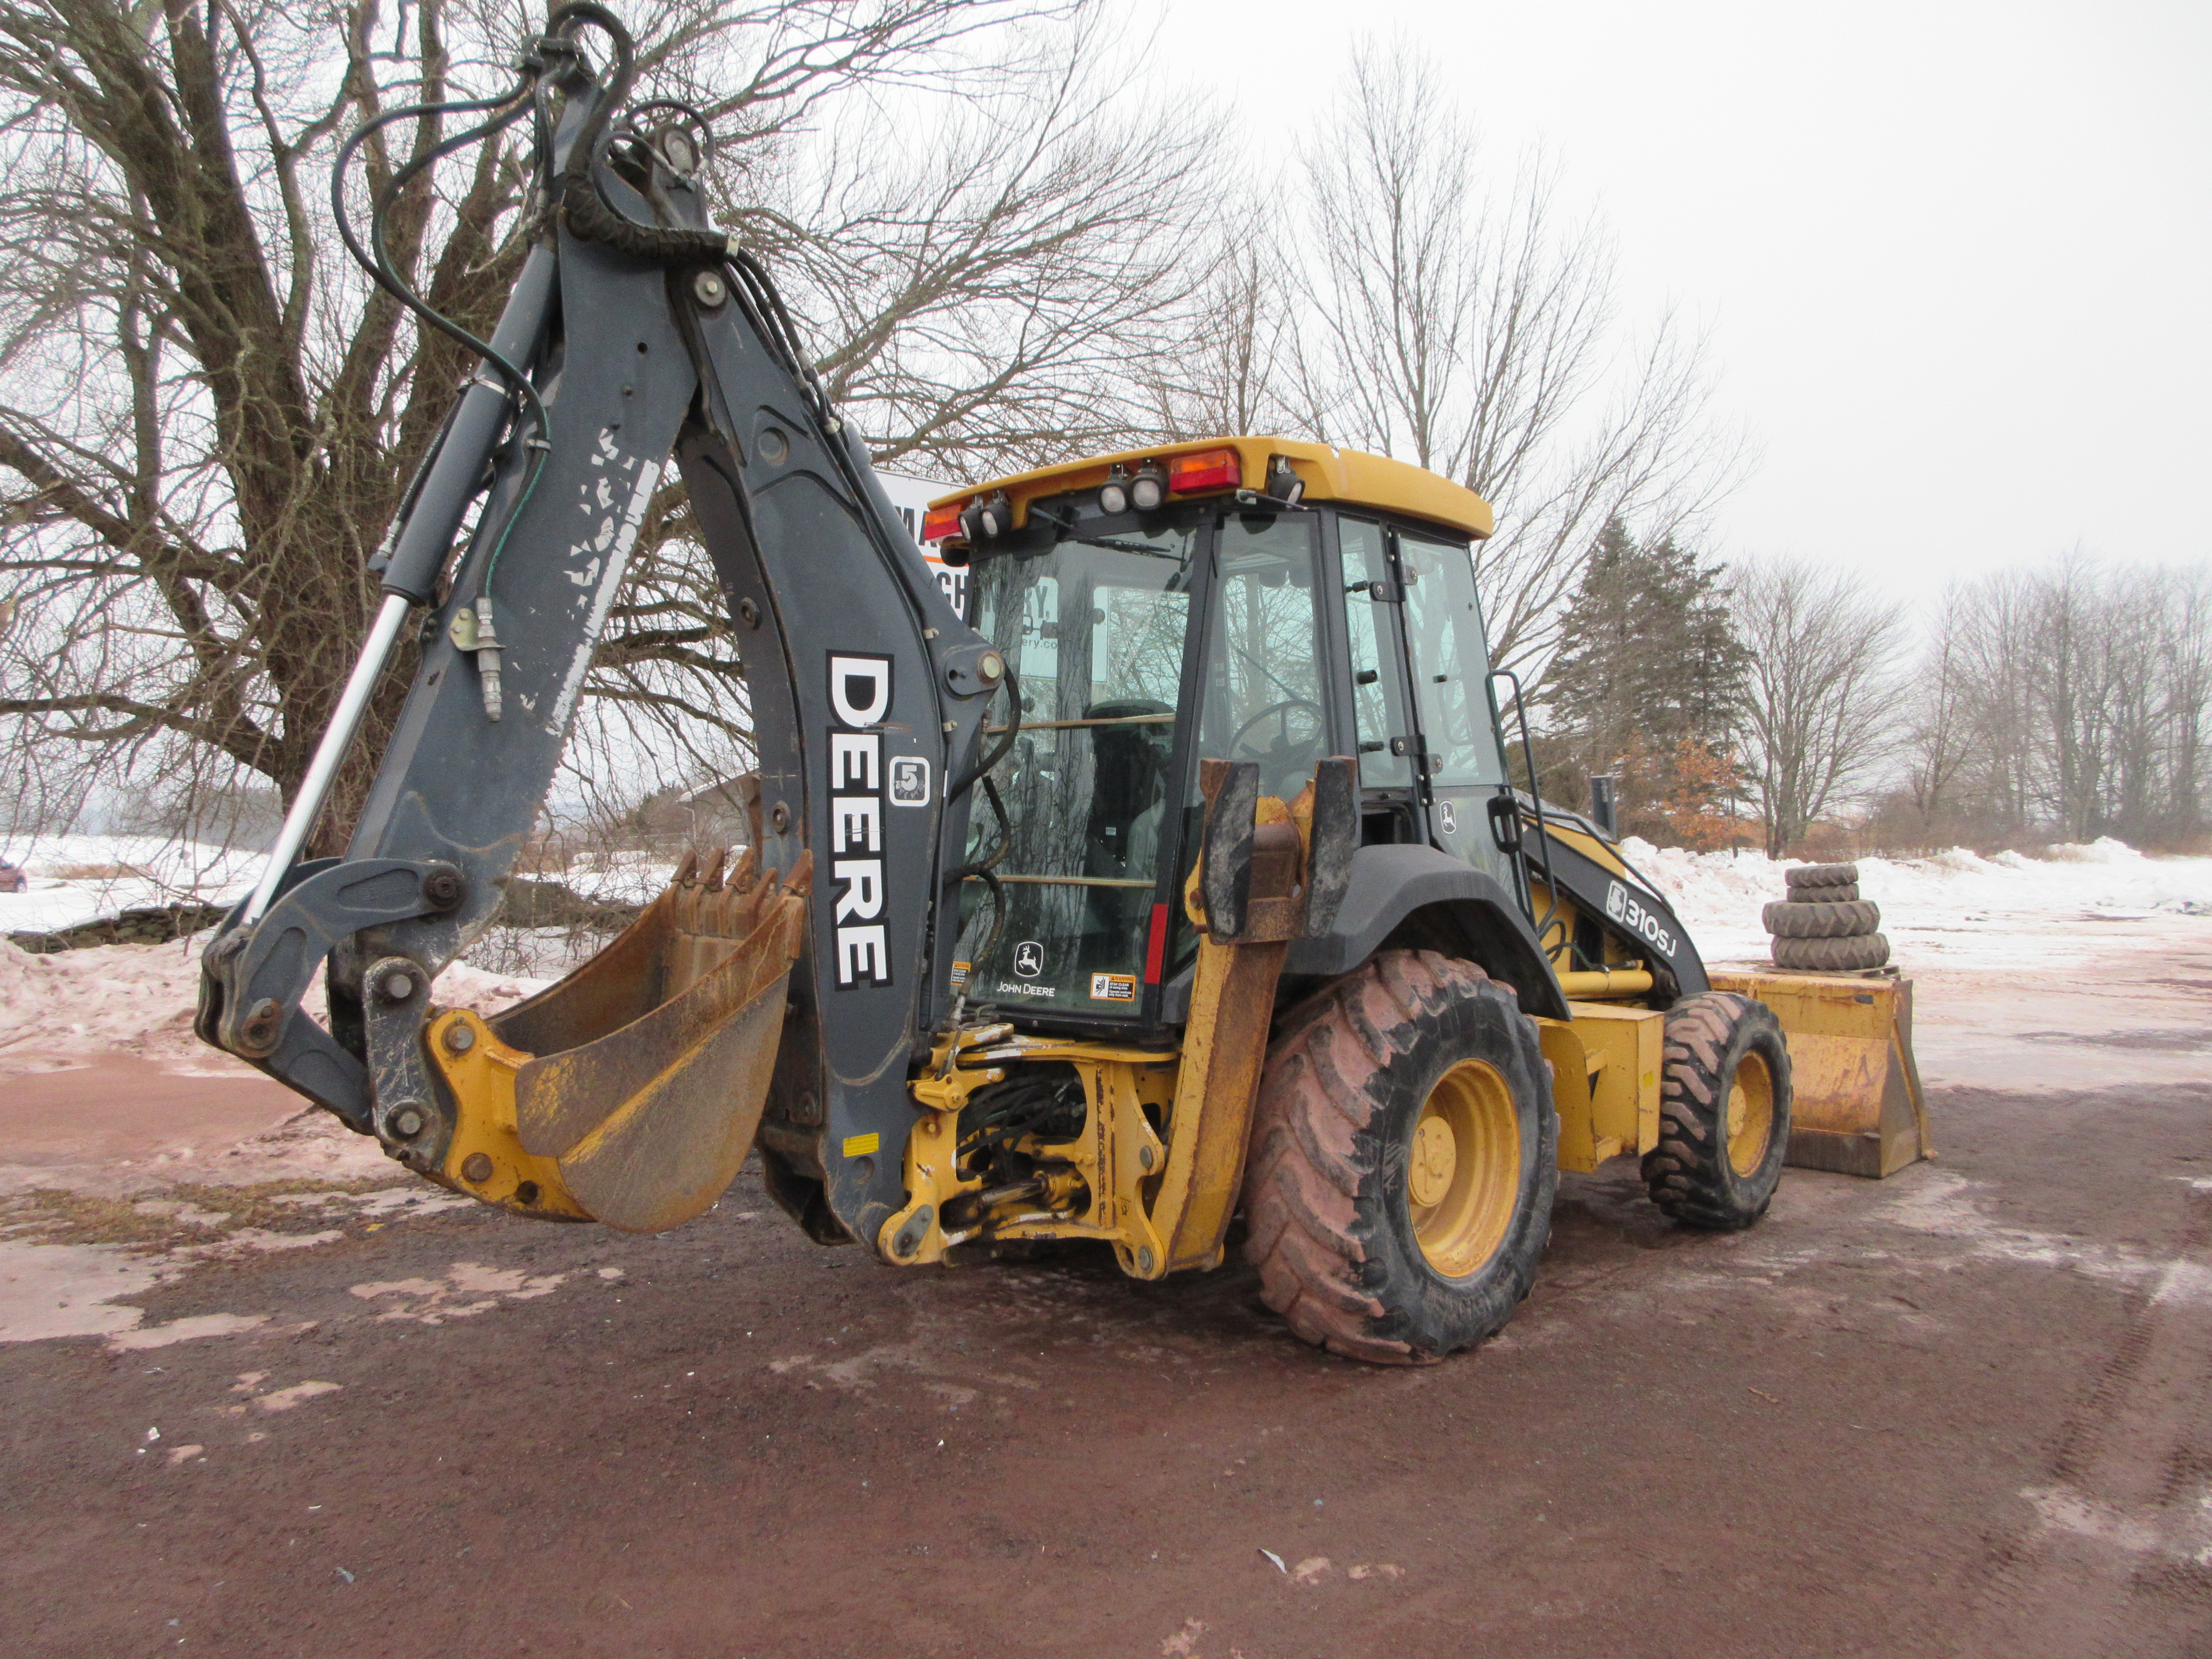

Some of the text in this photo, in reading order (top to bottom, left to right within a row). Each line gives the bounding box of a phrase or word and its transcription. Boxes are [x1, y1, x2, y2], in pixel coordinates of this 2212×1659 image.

[832, 657, 888, 984] DEERE
[1625, 899, 1677, 957] 310SJ
[997, 981, 1056, 997] JOHN DEERE
